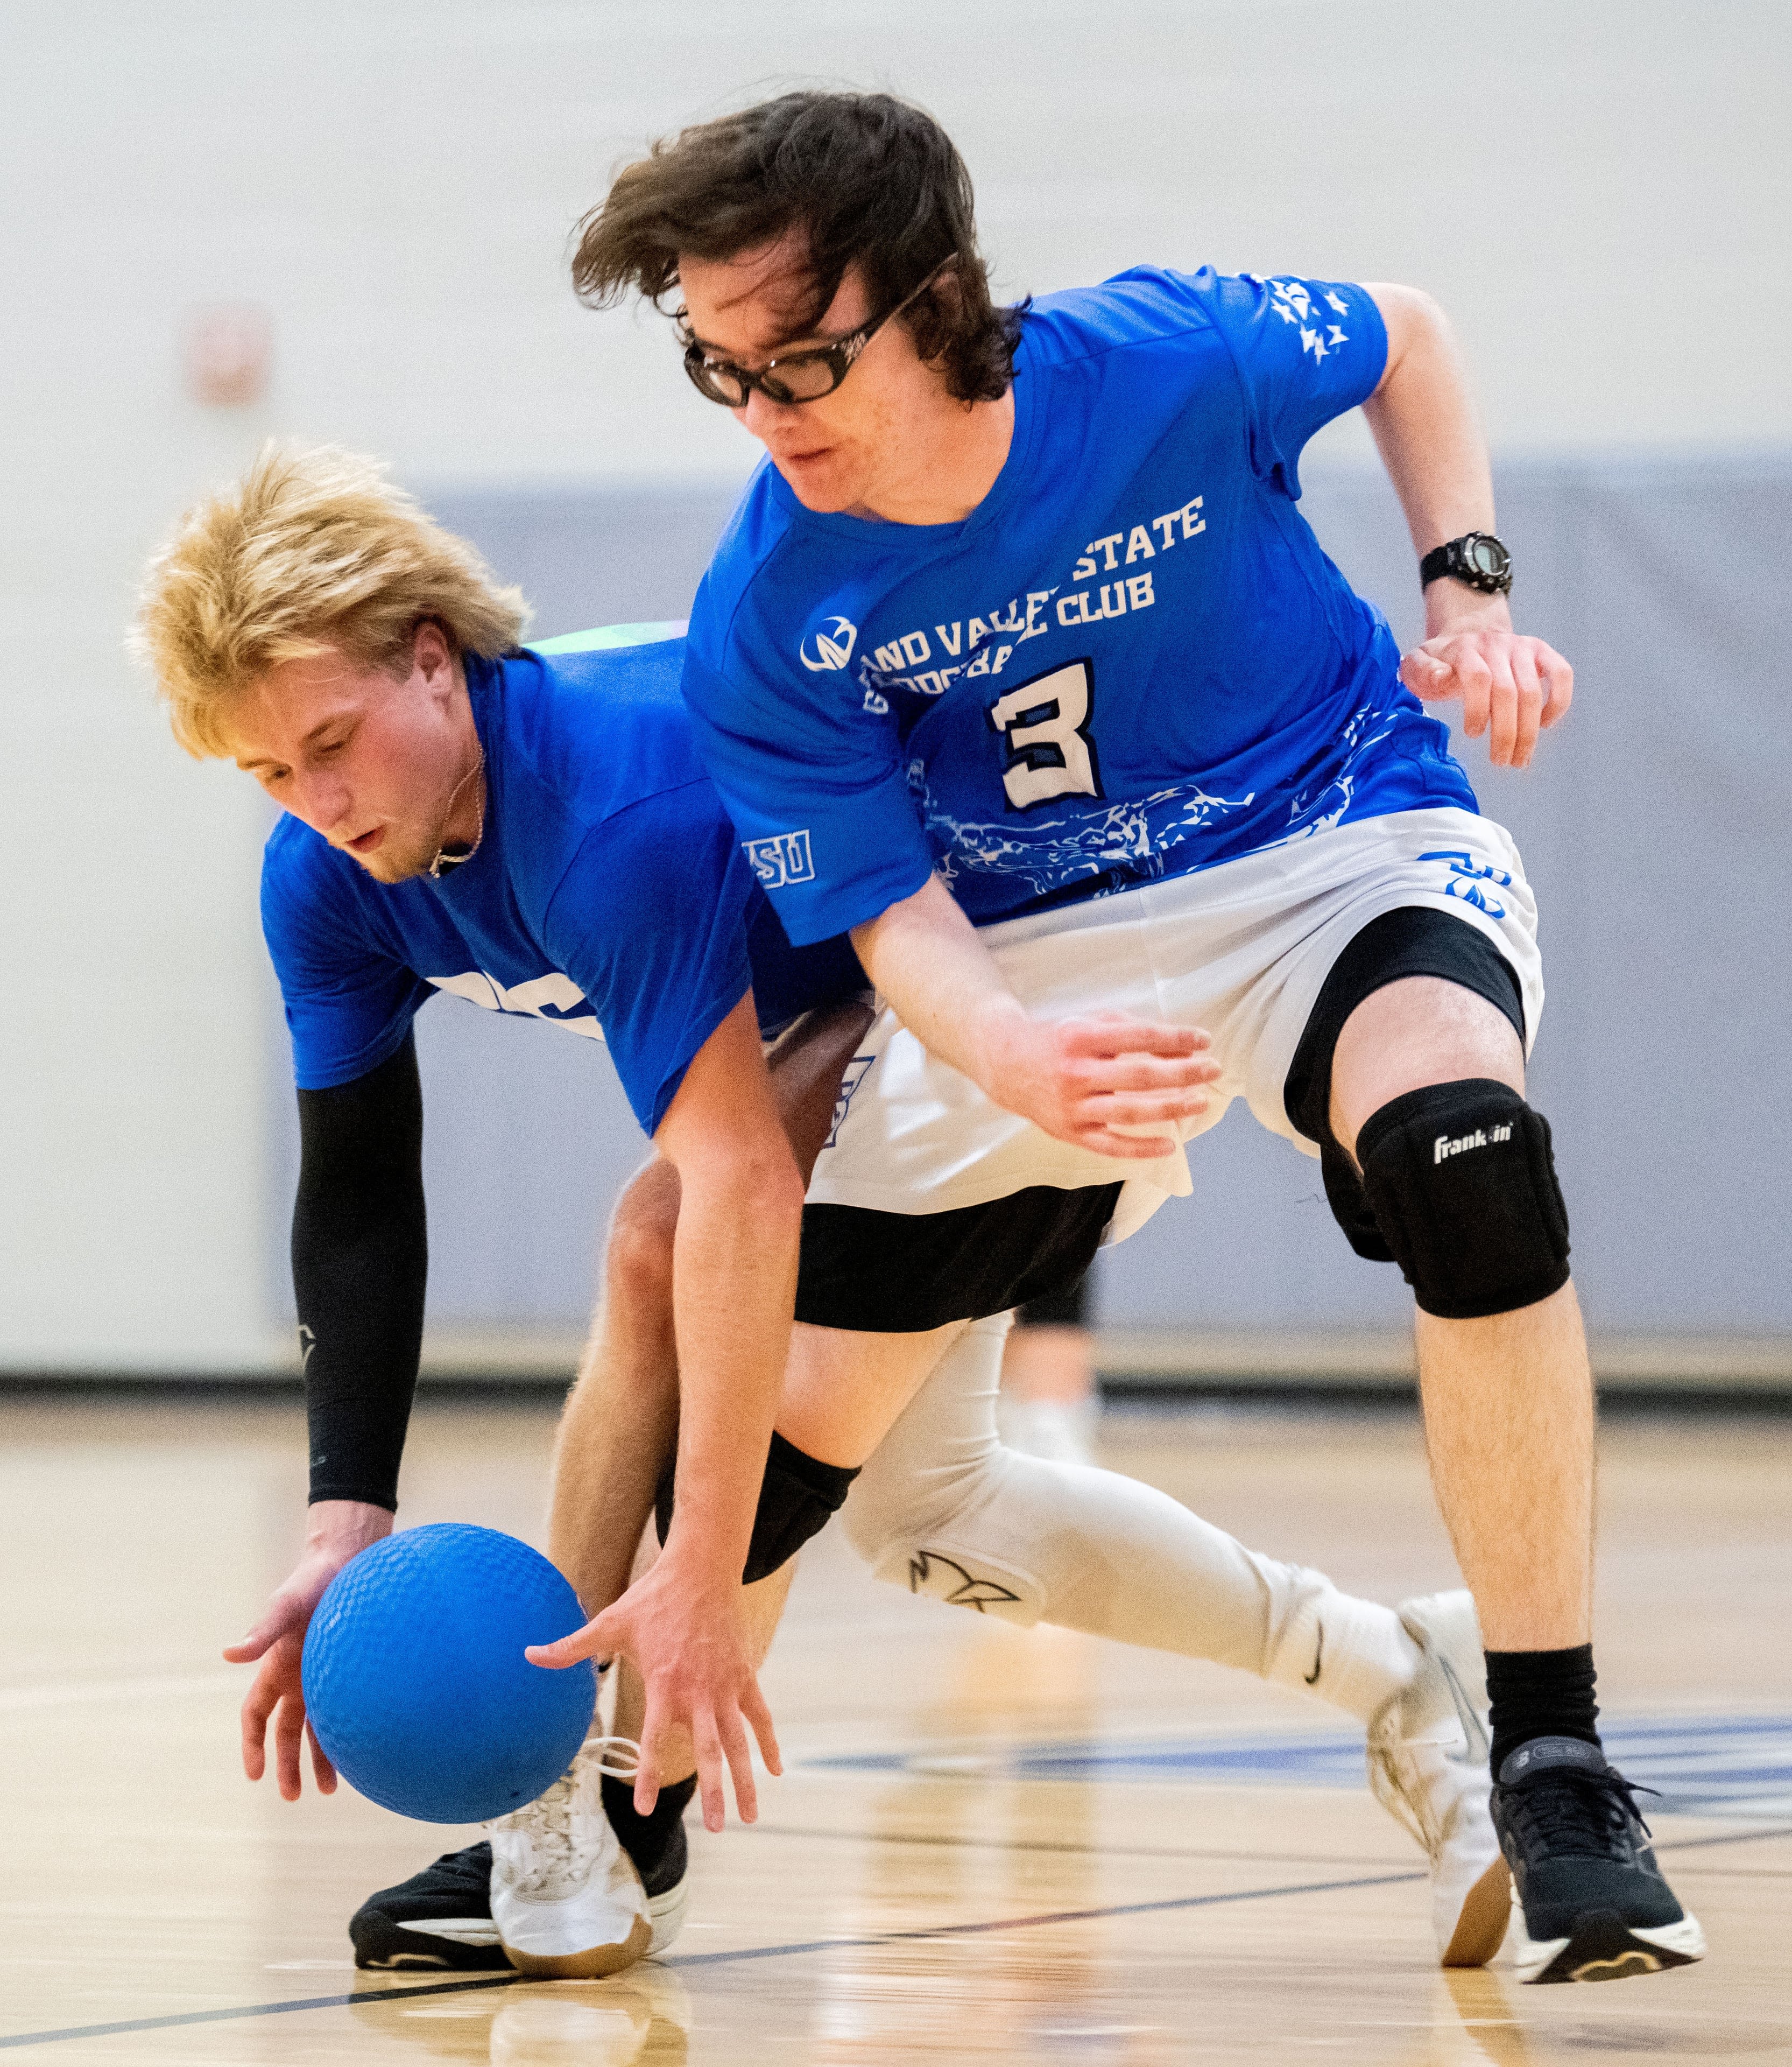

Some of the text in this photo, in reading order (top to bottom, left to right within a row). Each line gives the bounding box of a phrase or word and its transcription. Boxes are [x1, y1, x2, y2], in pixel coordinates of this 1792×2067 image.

[934, 584, 1061, 657] VALLE
[1073, 495, 1206, 581] STATE
[1056, 571, 1155, 626] CLUB
[987, 658, 1103, 812] 3
[741, 829, 815, 889] SU
[1434, 1121, 1512, 1164] frankin
